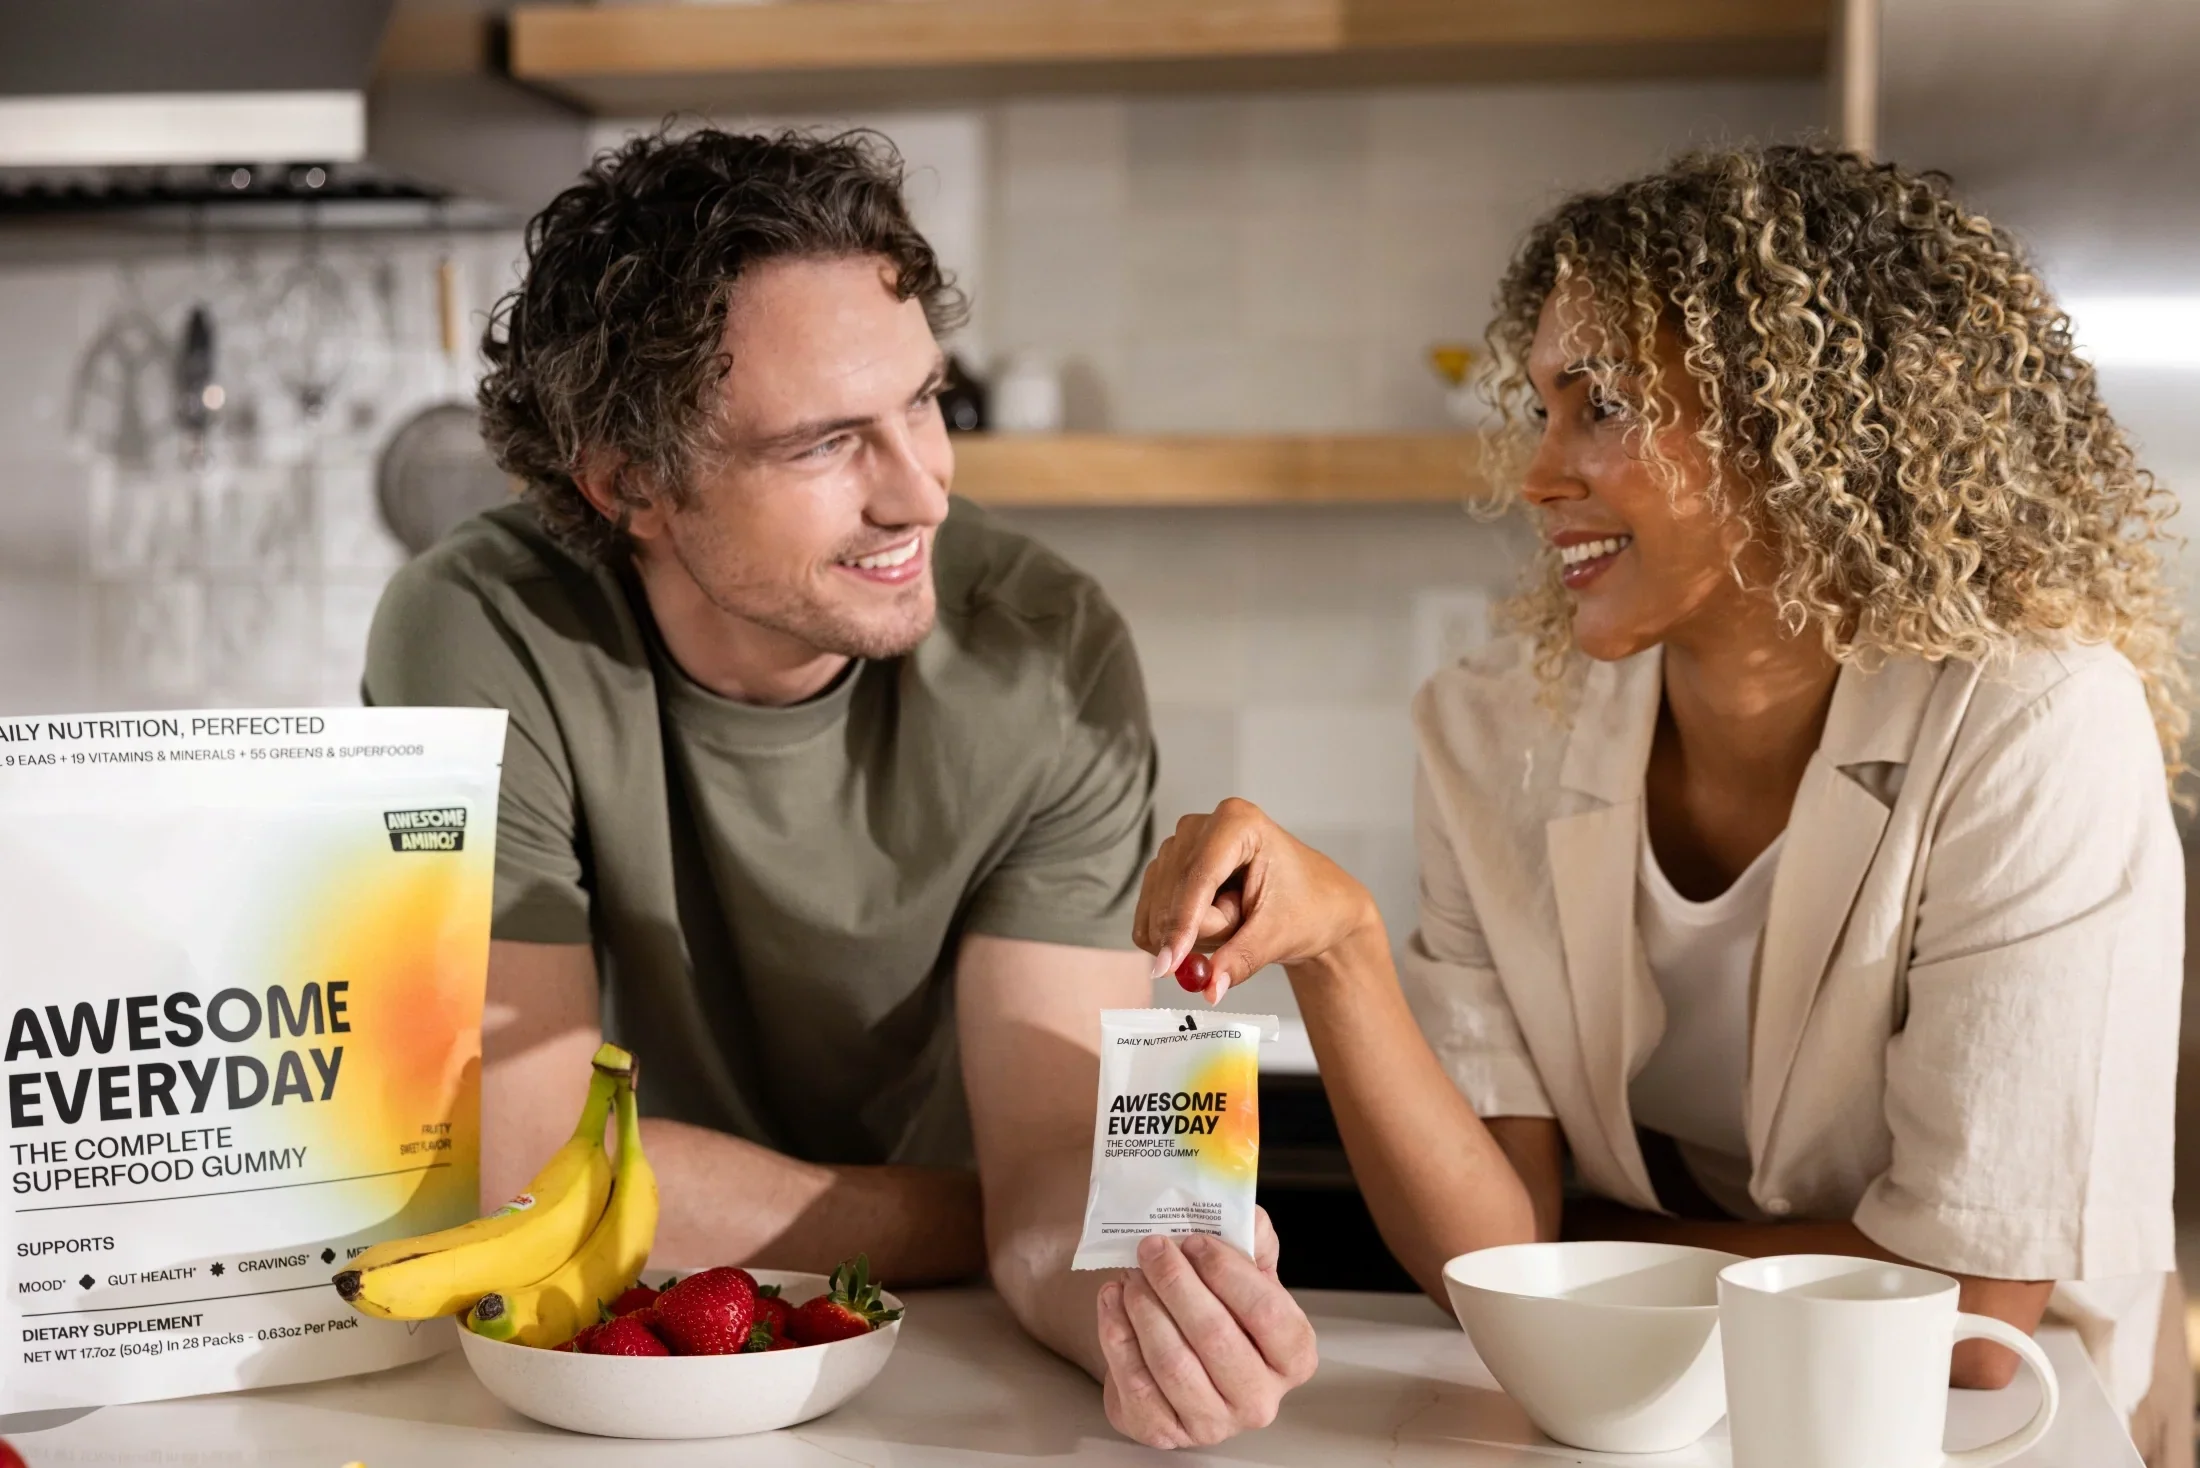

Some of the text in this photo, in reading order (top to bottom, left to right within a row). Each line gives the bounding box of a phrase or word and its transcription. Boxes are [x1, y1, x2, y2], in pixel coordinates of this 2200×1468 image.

[48, 718, 185, 740] NUTRITION,
[192, 716, 325, 736] PERFECTED
[5, 744, 424, 767] 9 EAAS + 19 VITAMINS & MINERALS + 55 GREENS & SUPERFOODS
[387, 808, 465, 829] AWESOME
[401, 831, 459, 850] AMINOS
[4, 981, 351, 1062] AWESOME
[1116, 1030, 1241, 1046] DAILY NUTRITION, PERFECTED
[8, 1046, 344, 1129] EVERYDAY
[1109, 1092, 1227, 1113] AWESOME
[1108, 1115, 1219, 1135] EVERYDAY
[10, 1127, 233, 1166] THE COMPLETE
[1105, 1148, 1199, 1158] SUPERFOOD GUMMY
[1106, 1139, 1175, 1148] THE COMPLETE
[12, 1146, 308, 1194] SUPERFOOD GUMMY
[17, 1236, 115, 1257] SUPPORTS
[108, 1273, 137, 1286] GUT
[22, 1314, 203, 1342] DIETARY SUPPLEMENT
[24, 1350, 51, 1364] NET
[55, 1348, 77, 1361] WT
[80, 1347, 116, 1360] 17.7oz
[120, 1340, 163, 1358] (504g)
[167, 1340, 179, 1352] In
[183, 1338, 199, 1350] 28
[203, 1332, 245, 1347] Packs
[258, 1326, 302, 1341] 0.63oz
[304, 1322, 326, 1334] Per
[328, 1316, 358, 1332] Pack
